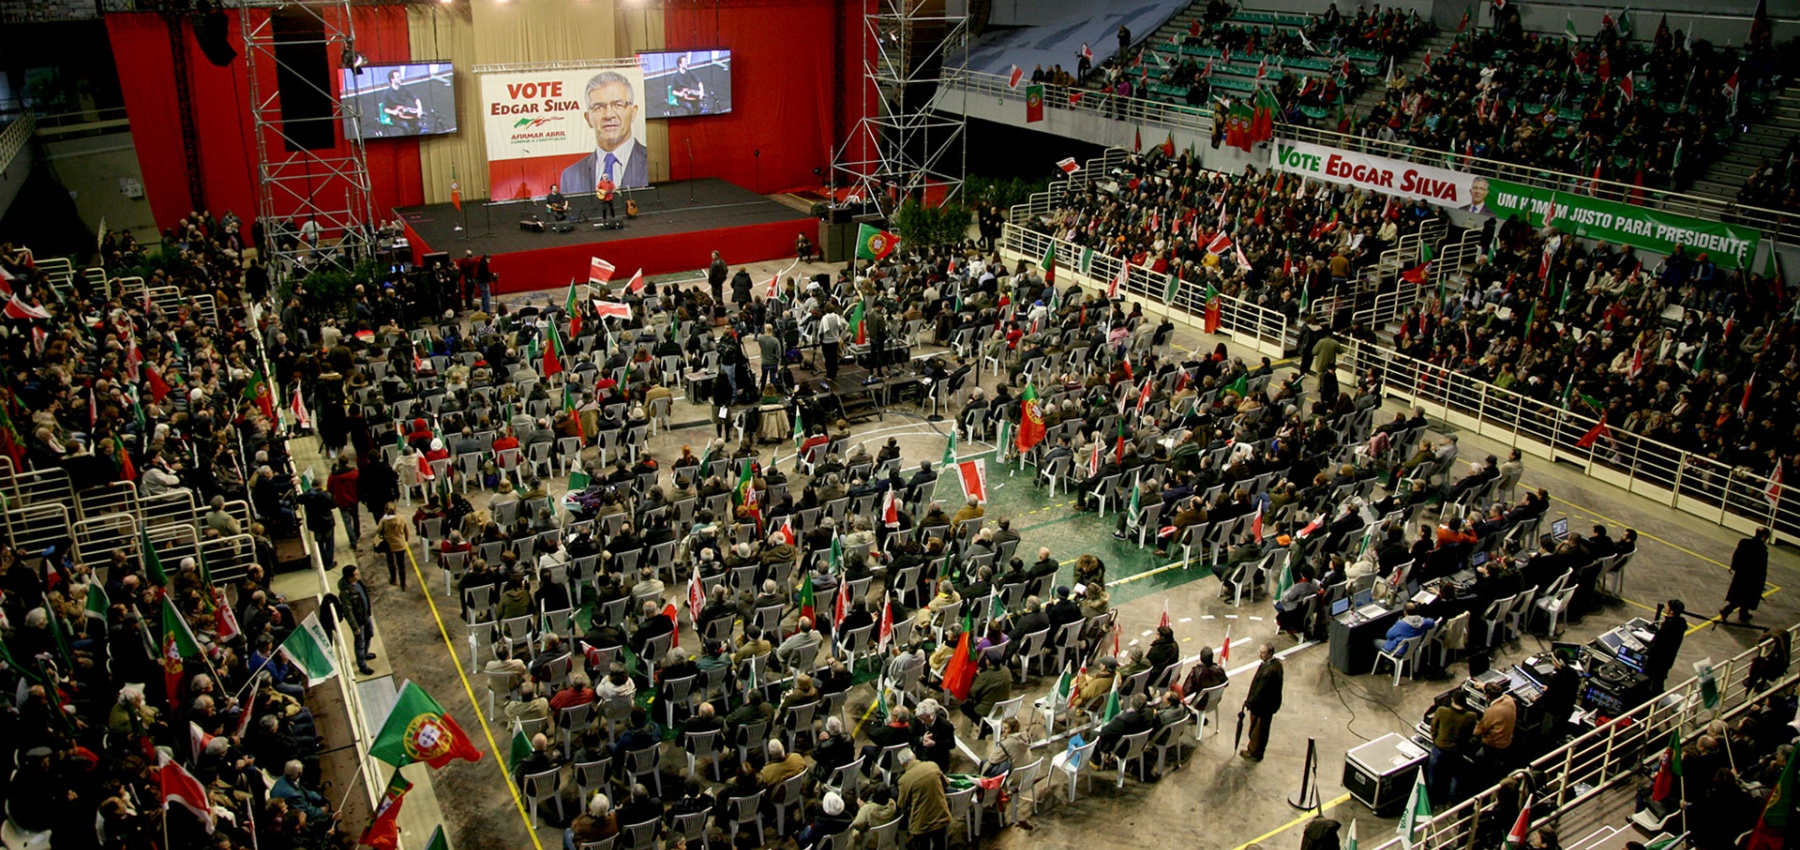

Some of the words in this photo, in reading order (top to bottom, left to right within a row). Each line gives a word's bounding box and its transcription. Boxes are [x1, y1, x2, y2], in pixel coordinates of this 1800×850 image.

[491, 102, 540, 116] EDGAR
[544, 99, 580, 112] SILVA
[507, 81, 563, 100] VOTE
[1277, 144, 1322, 172] VOTE
[1325, 153, 1395, 188] EDGAR
[1400, 169, 1458, 202] SILVA
[1497, 192, 1518, 209] UM
[1569, 207, 1613, 229] JUSTO
[1614, 215, 1652, 237] PARA
[1655, 224, 1750, 257] PRESIDENTE
